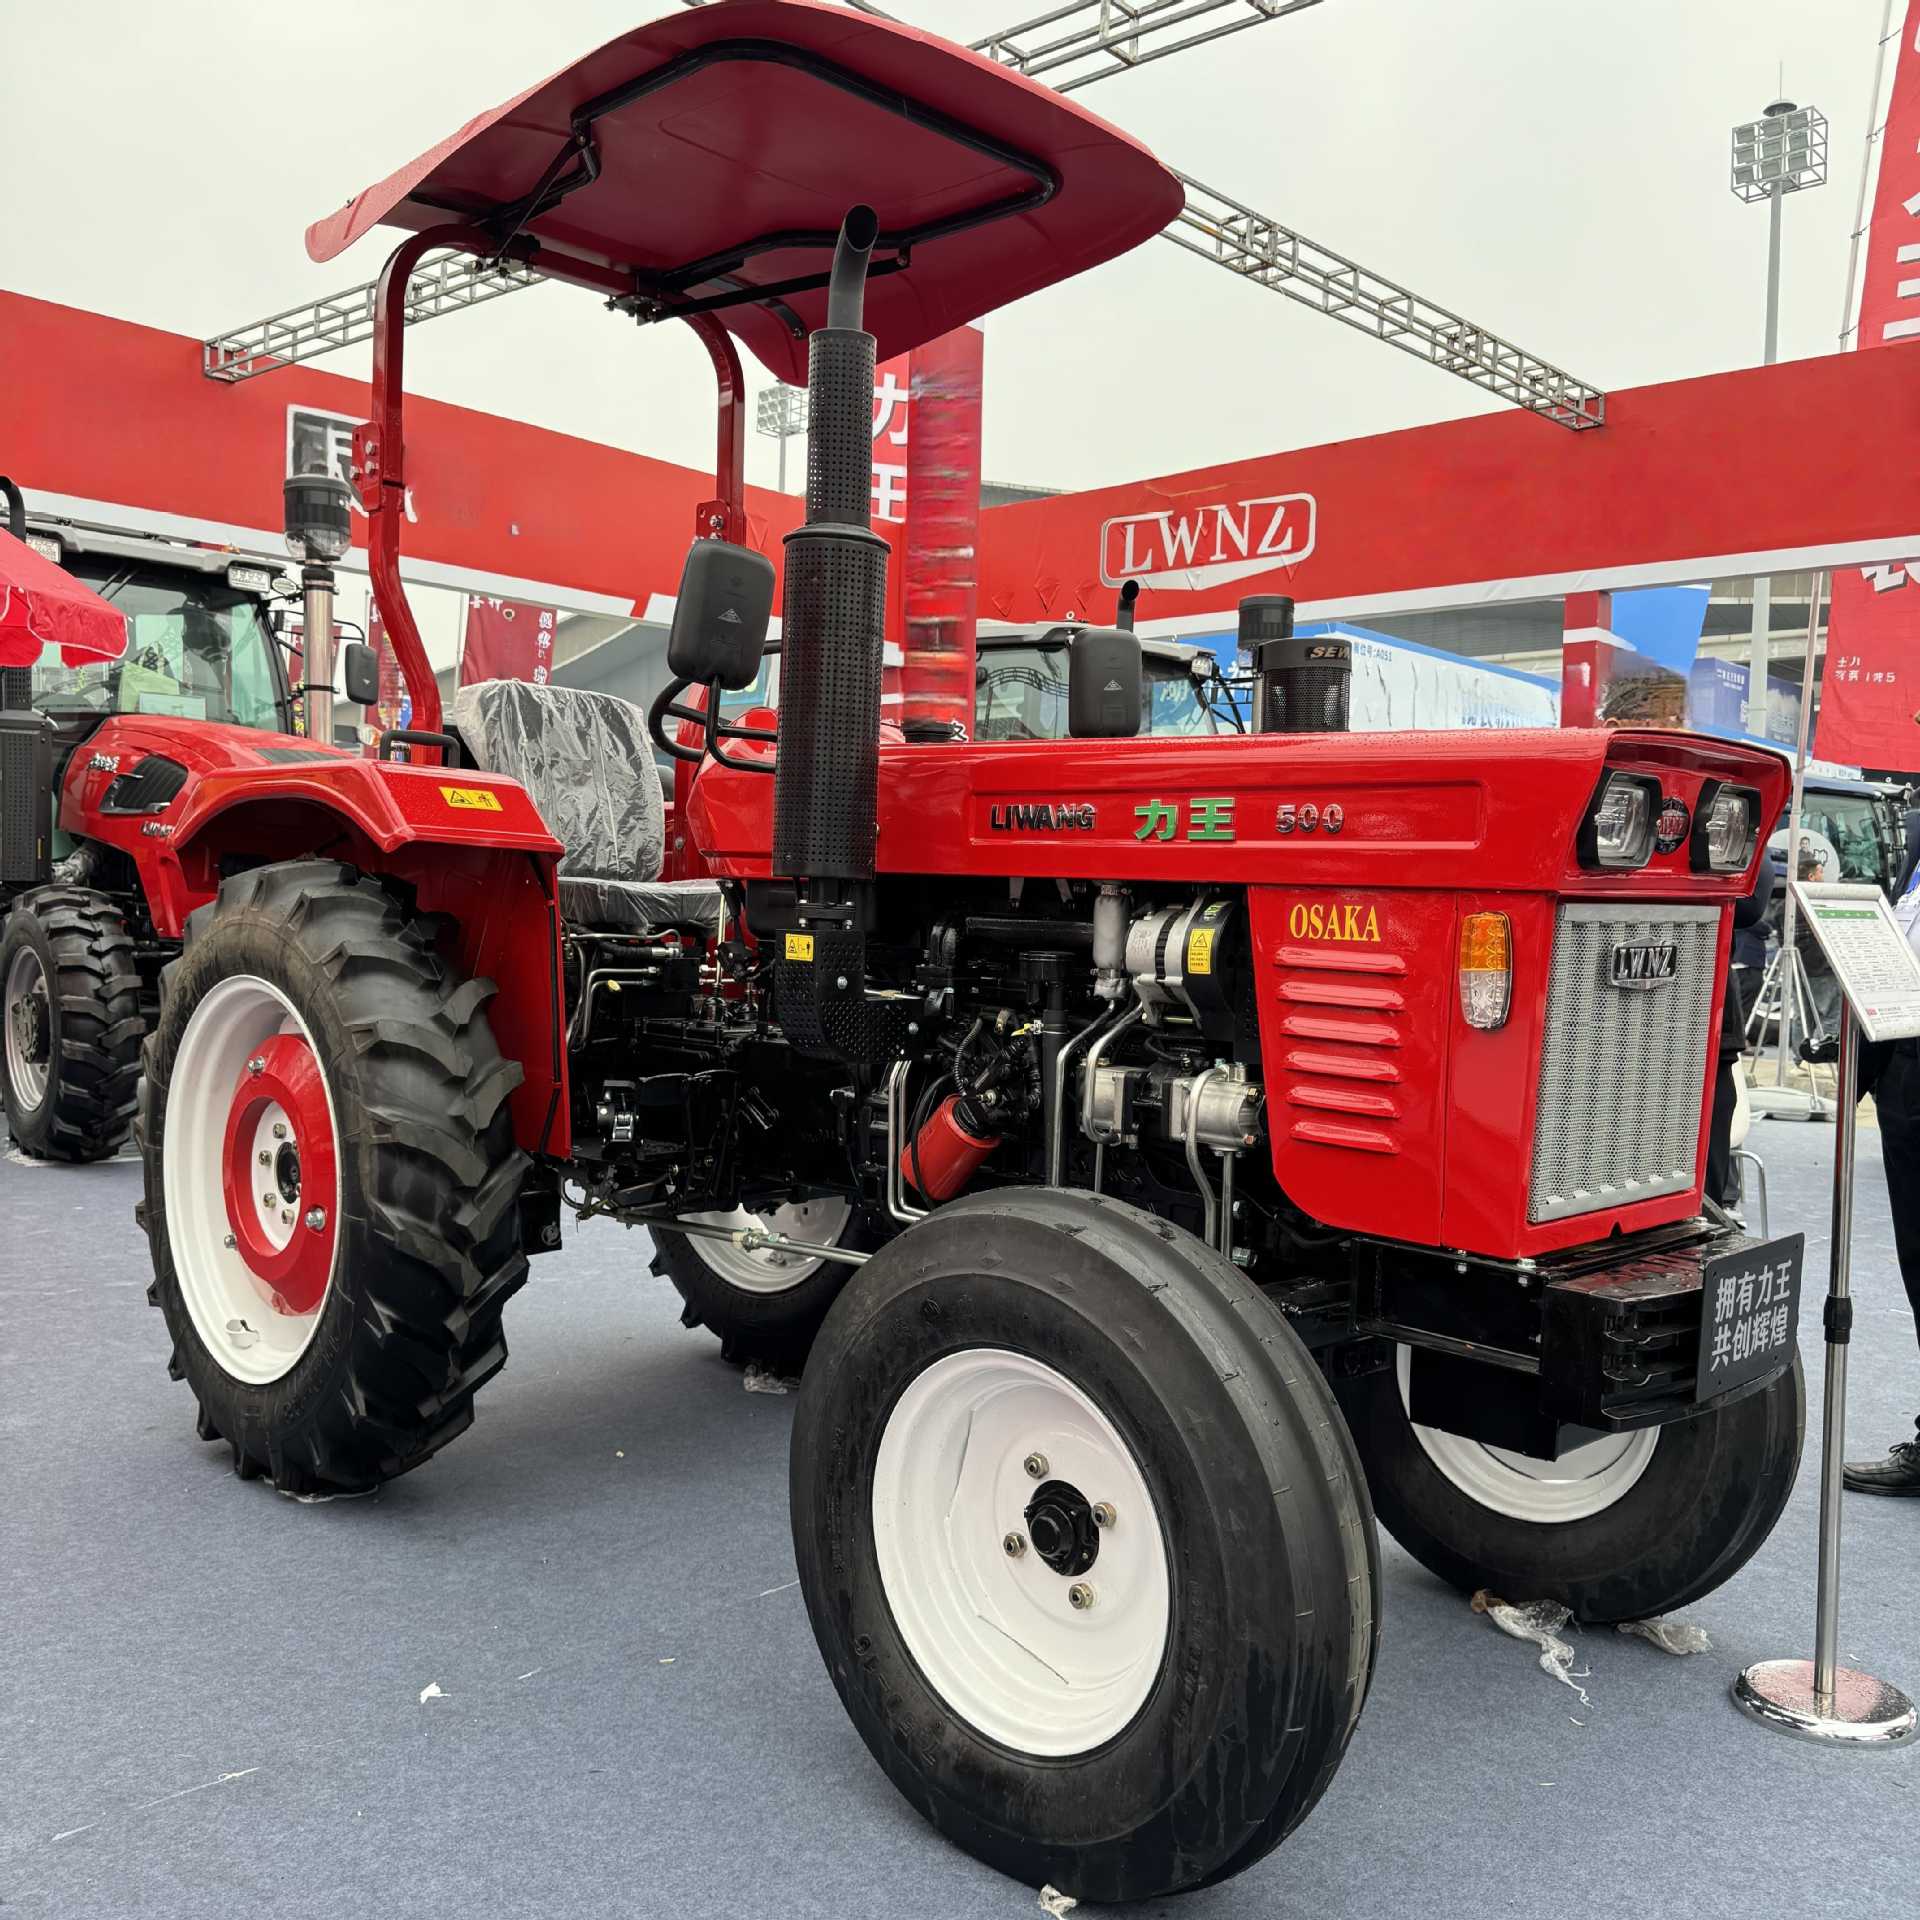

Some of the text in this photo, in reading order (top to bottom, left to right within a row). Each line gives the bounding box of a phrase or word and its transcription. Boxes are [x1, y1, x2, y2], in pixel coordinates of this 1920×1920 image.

[1119, 503, 1294, 575] LWNZ
[991, 796, 1344, 842] LIWANG 力王 500
[1289, 903, 1382, 942] OSAKA
[1615, 945, 1675, 980] LWNZ
[1715, 1260, 1792, 1323] 拥有力王
[1711, 1303, 1788, 1371] 共创辉煌
